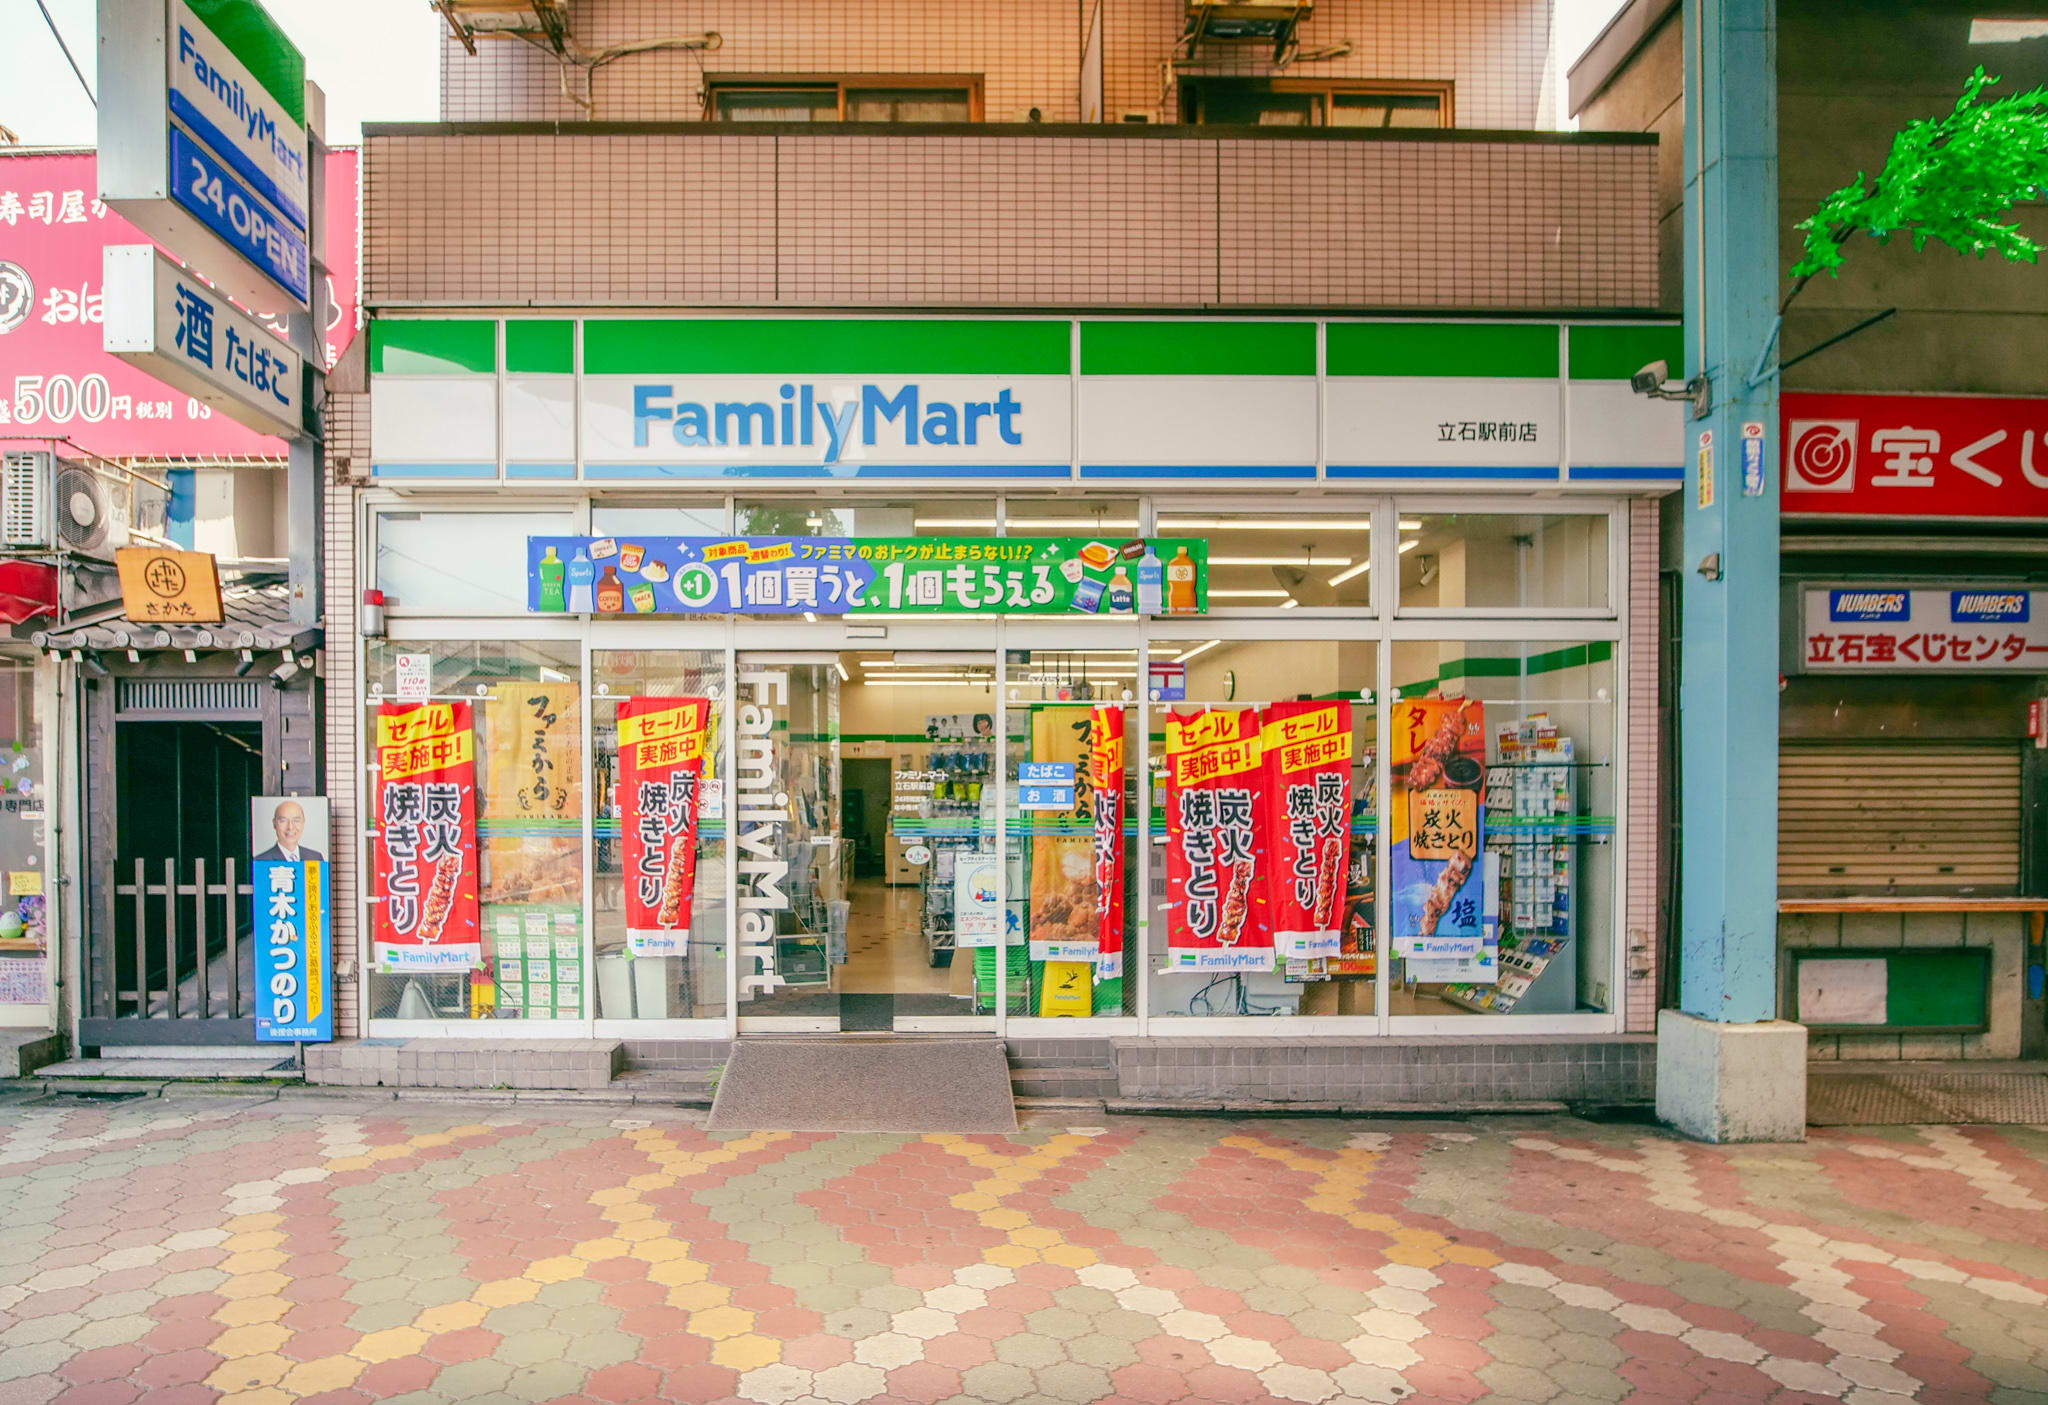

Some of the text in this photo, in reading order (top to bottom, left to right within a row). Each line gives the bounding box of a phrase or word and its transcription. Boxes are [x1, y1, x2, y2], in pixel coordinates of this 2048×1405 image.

[178, 23, 306, 182] FamilyMart
[191, 156, 302, 281] 24 OPEN
[175, 282, 290, 406] 酒 たばこ
[135, 400, 173, 419] 税別
[632, 383, 1023, 463] FamilyMart
[1438, 421, 1537, 442] 立石駅前店
[707, 543, 748, 558] 対象商品
[801, 543, 1033, 561] ファミマのおトクが止まらない!?
[721, 561, 1055, 609] 1個買うと、1個もらえる
[1111, 594, 1131, 604] Latte
[1836, 594, 1905, 613] NUMBERS
[1957, 595, 2024, 614] NUMBERS
[1808, 633, 2048, 663] 立石宝くじセンター
[388, 710, 448, 742] セール
[638, 709, 693, 737] セール
[1179, 715, 1233, 747] セール
[1281, 713, 1334, 739] セール
[1408, 706, 1428, 754] タレ
[385, 735, 462, 776] 実施中!
[1180, 741, 1251, 781] 実施中!
[1284, 736, 1345, 770] 実施中!
[894, 771, 949, 780] ファミリーマート
[1027, 765, 1065, 778] たばこ
[669, 771, 697, 838] 炭火
[1315, 773, 1344, 840] 炭火
[1423, 809, 1463, 830] 炭火
[422, 782, 463, 860] 炭火
[737, 671, 788, 994] FamilyMart
[1216, 789, 1256, 866] 炭火
[640, 782, 669, 908] 焼きとり
[1287, 785, 1316, 910] 焼きとり
[1413, 830, 1474, 850] 焼きとり
[384, 784, 420, 935] 焼きとり
[1181, 790, 1218, 938] 焼きとり
[1452, 899, 1477, 928] 塩
[269, 866, 297, 1024] 青木かつのり
[402, 950, 470, 963] FamilyMart
[647, 938, 676, 952] Family
[1063, 947, 1098, 957] FamilyM
[1308, 938, 1339, 949] FamilyMa
[1426, 943, 1474, 953] FamilyMart
[1200, 954, 1266, 967] FamilyMart
